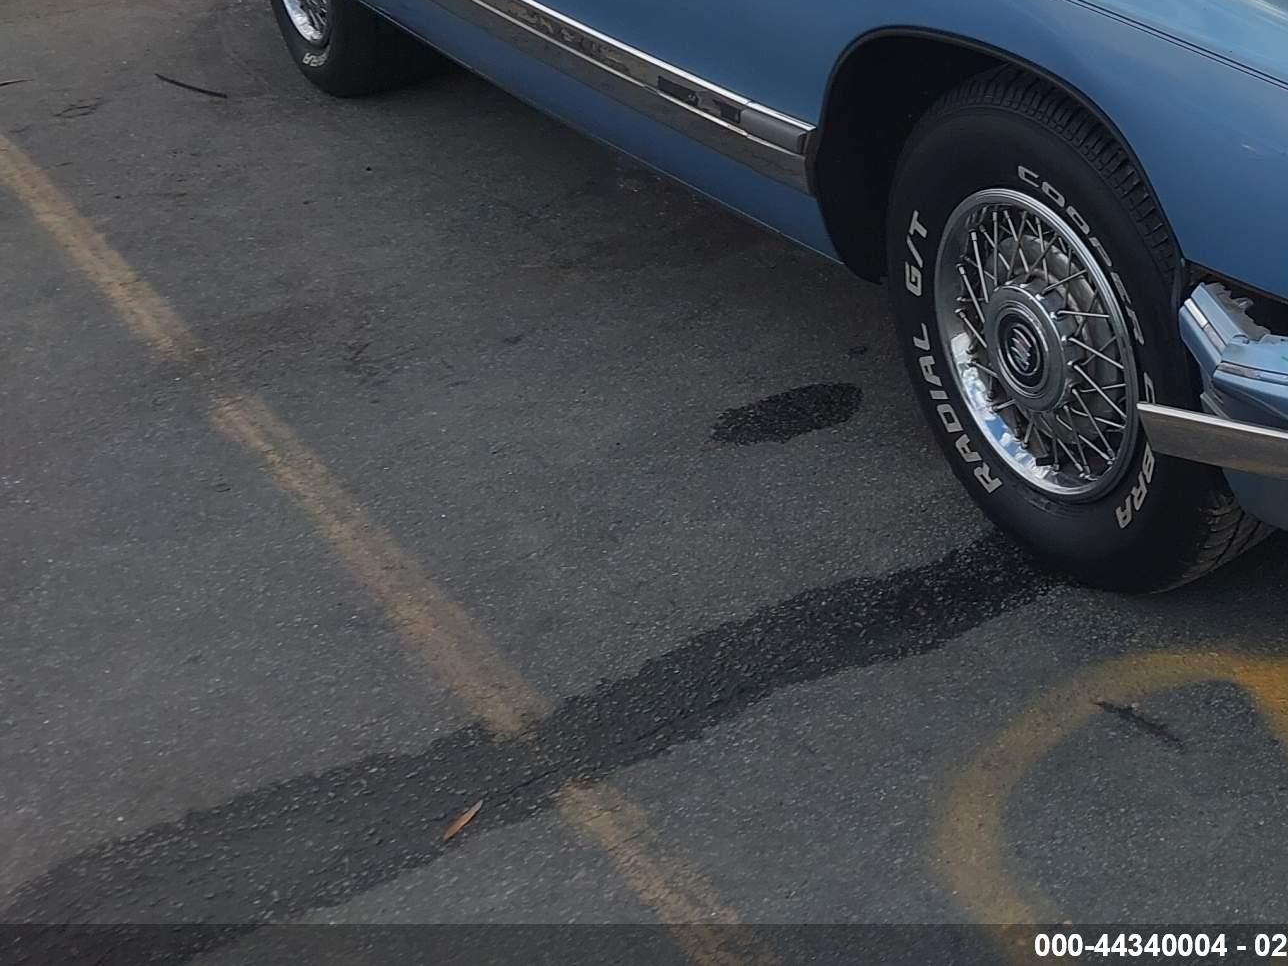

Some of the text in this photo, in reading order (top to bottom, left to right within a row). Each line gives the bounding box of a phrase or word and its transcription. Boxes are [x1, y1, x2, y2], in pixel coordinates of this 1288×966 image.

[904, 209, 1003, 494] RADIAL G/T
[1018, 165, 1156, 529] COOPER CBRA
